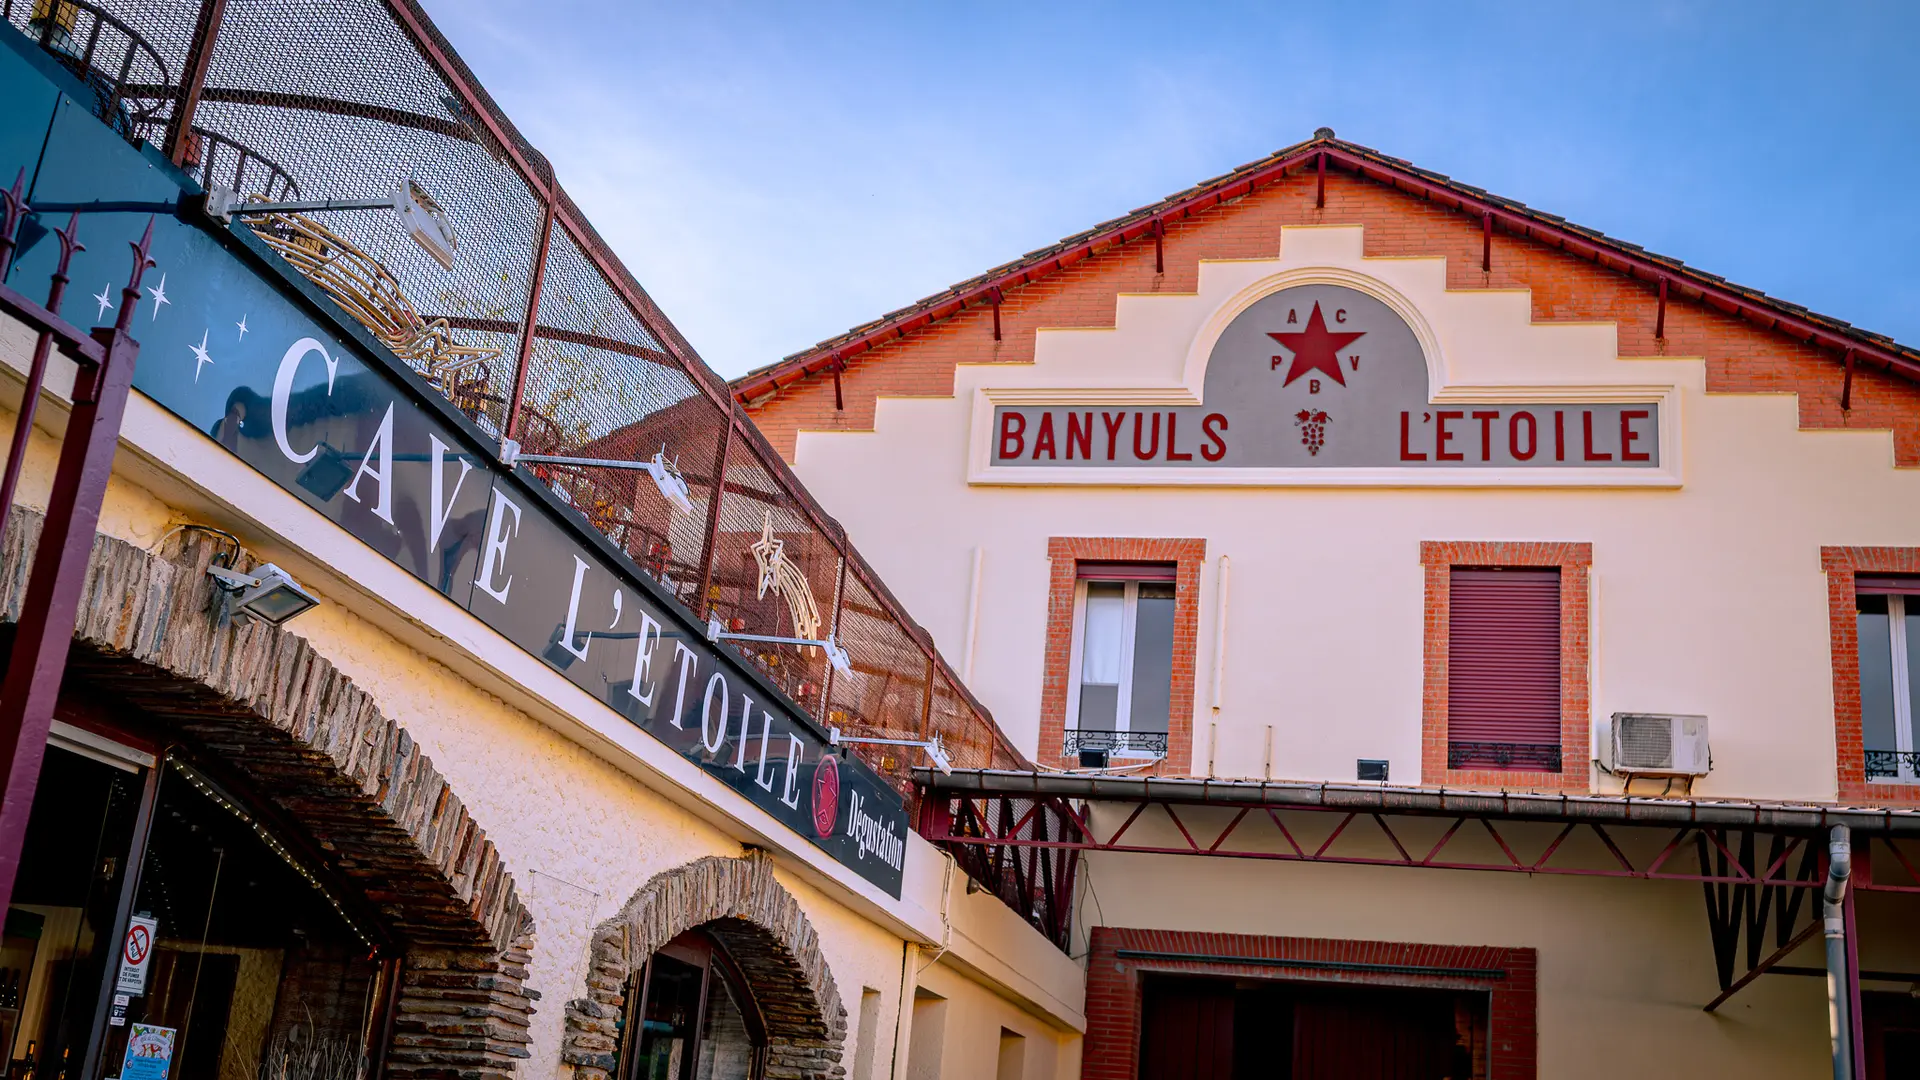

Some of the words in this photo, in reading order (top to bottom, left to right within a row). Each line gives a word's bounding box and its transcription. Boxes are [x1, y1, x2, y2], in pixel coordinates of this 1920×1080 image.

[1287, 308, 1297, 324] A
[1335, 308, 1347, 324] C
[1271, 355, 1283, 371] P
[1349, 355, 1360, 371] V
[1309, 379, 1321, 394] B
[999, 412, 1229, 462] BANYULS
[1400, 410, 1651, 462] L'ETOILE
[271, 337, 522, 605] CAVE
[558, 554, 805, 811] L'ETOILE
[847, 788, 903, 872] Dégustation
